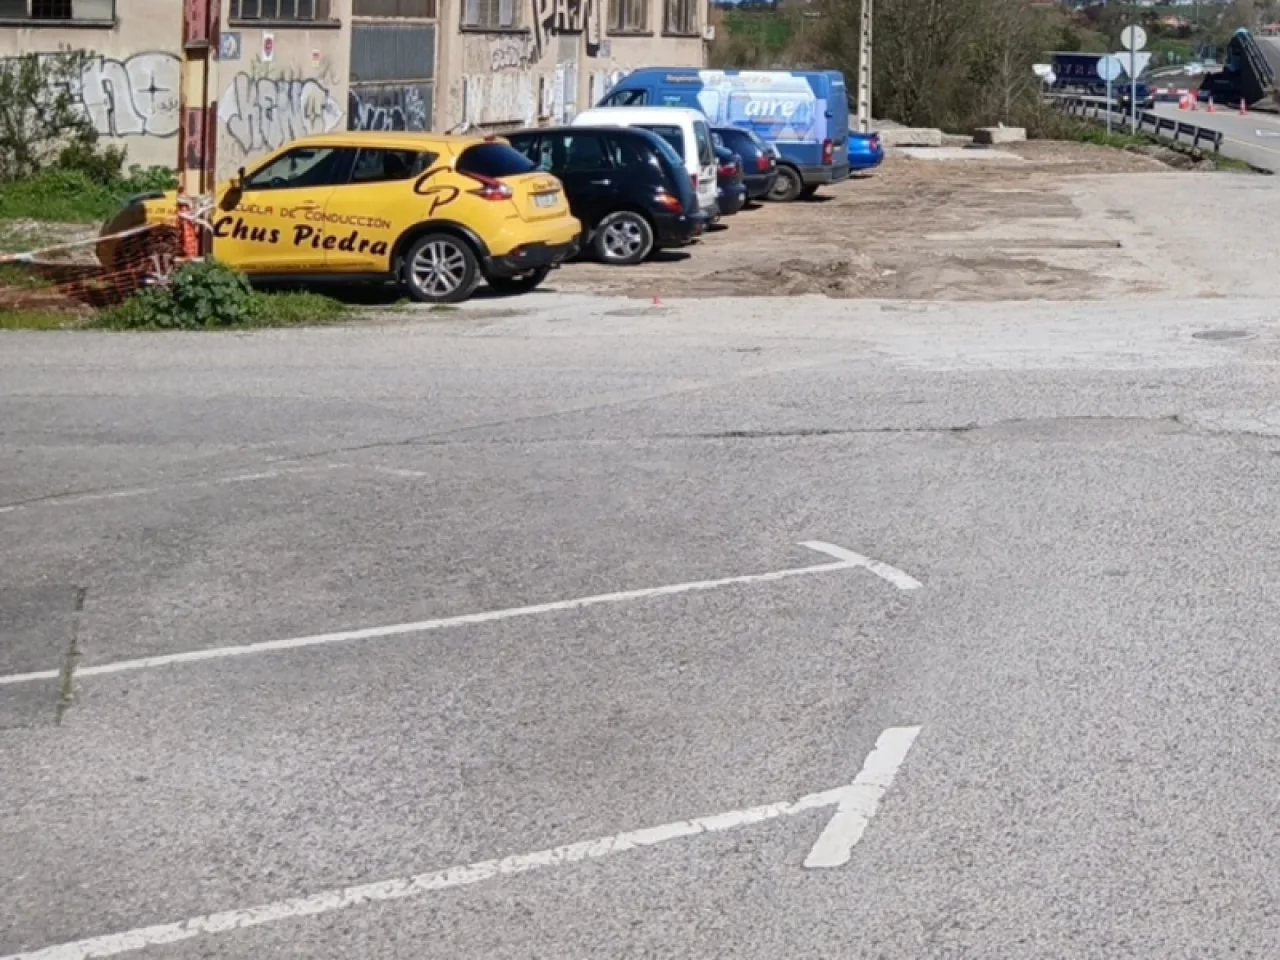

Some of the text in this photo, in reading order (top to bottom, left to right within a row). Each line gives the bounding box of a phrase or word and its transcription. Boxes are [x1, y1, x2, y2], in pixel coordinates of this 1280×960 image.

[280, 207, 297, 219] DE
[213, 215, 388, 256] Chus Piedra
